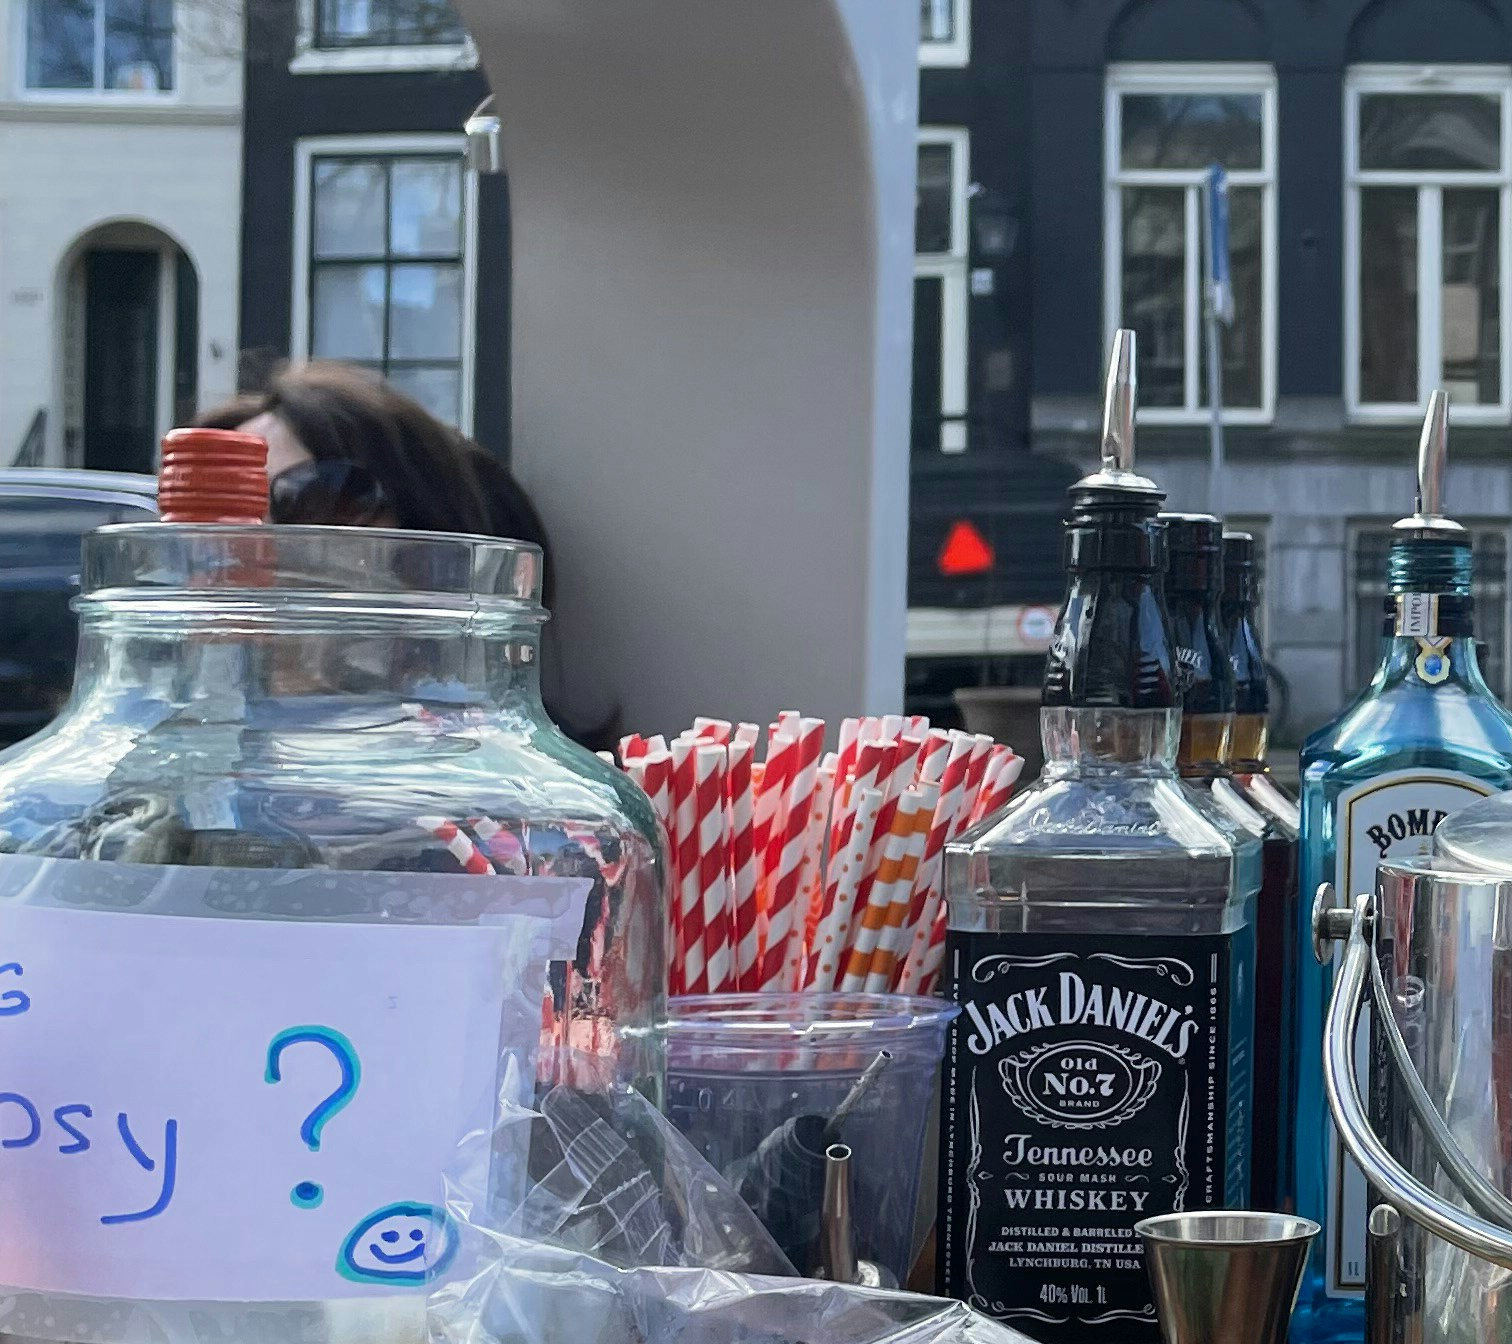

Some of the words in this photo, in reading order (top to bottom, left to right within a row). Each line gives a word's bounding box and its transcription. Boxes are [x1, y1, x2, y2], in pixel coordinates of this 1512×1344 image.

[964, 985, 1056, 1056] JACK
[1058, 971, 1200, 1059] DANIEL'S
[1208, 1026, 1217, 1070] SINCE
[1060, 1057, 1098, 1071] Old
[1058, 1099, 1101, 1109] BRAND
[264, 1024, 361, 1209] ?
[1002, 1133, 1153, 1167] Tennessee
[1204, 1075, 1216, 1205] CRAFTSMANSHIP
[1038, 1172, 1074, 1183] SOUR
[1079, 1172, 1117, 1183] MASH
[1003, 1188, 1150, 1212] WHISKEY
[1001, 1226, 1059, 1237] DISTILLED
[1073, 1226, 1133, 1238] BARRELED
[988, 1241, 1024, 1253] JACK
[1026, 1241, 1079, 1253] DANIEL
[1081, 1242, 1145, 1254] DISTILLE
[1093, 1258, 1112, 1269] TN
[1115, 1258, 1142, 1270] USA
[1039, 1283, 1069, 1304] 40%
